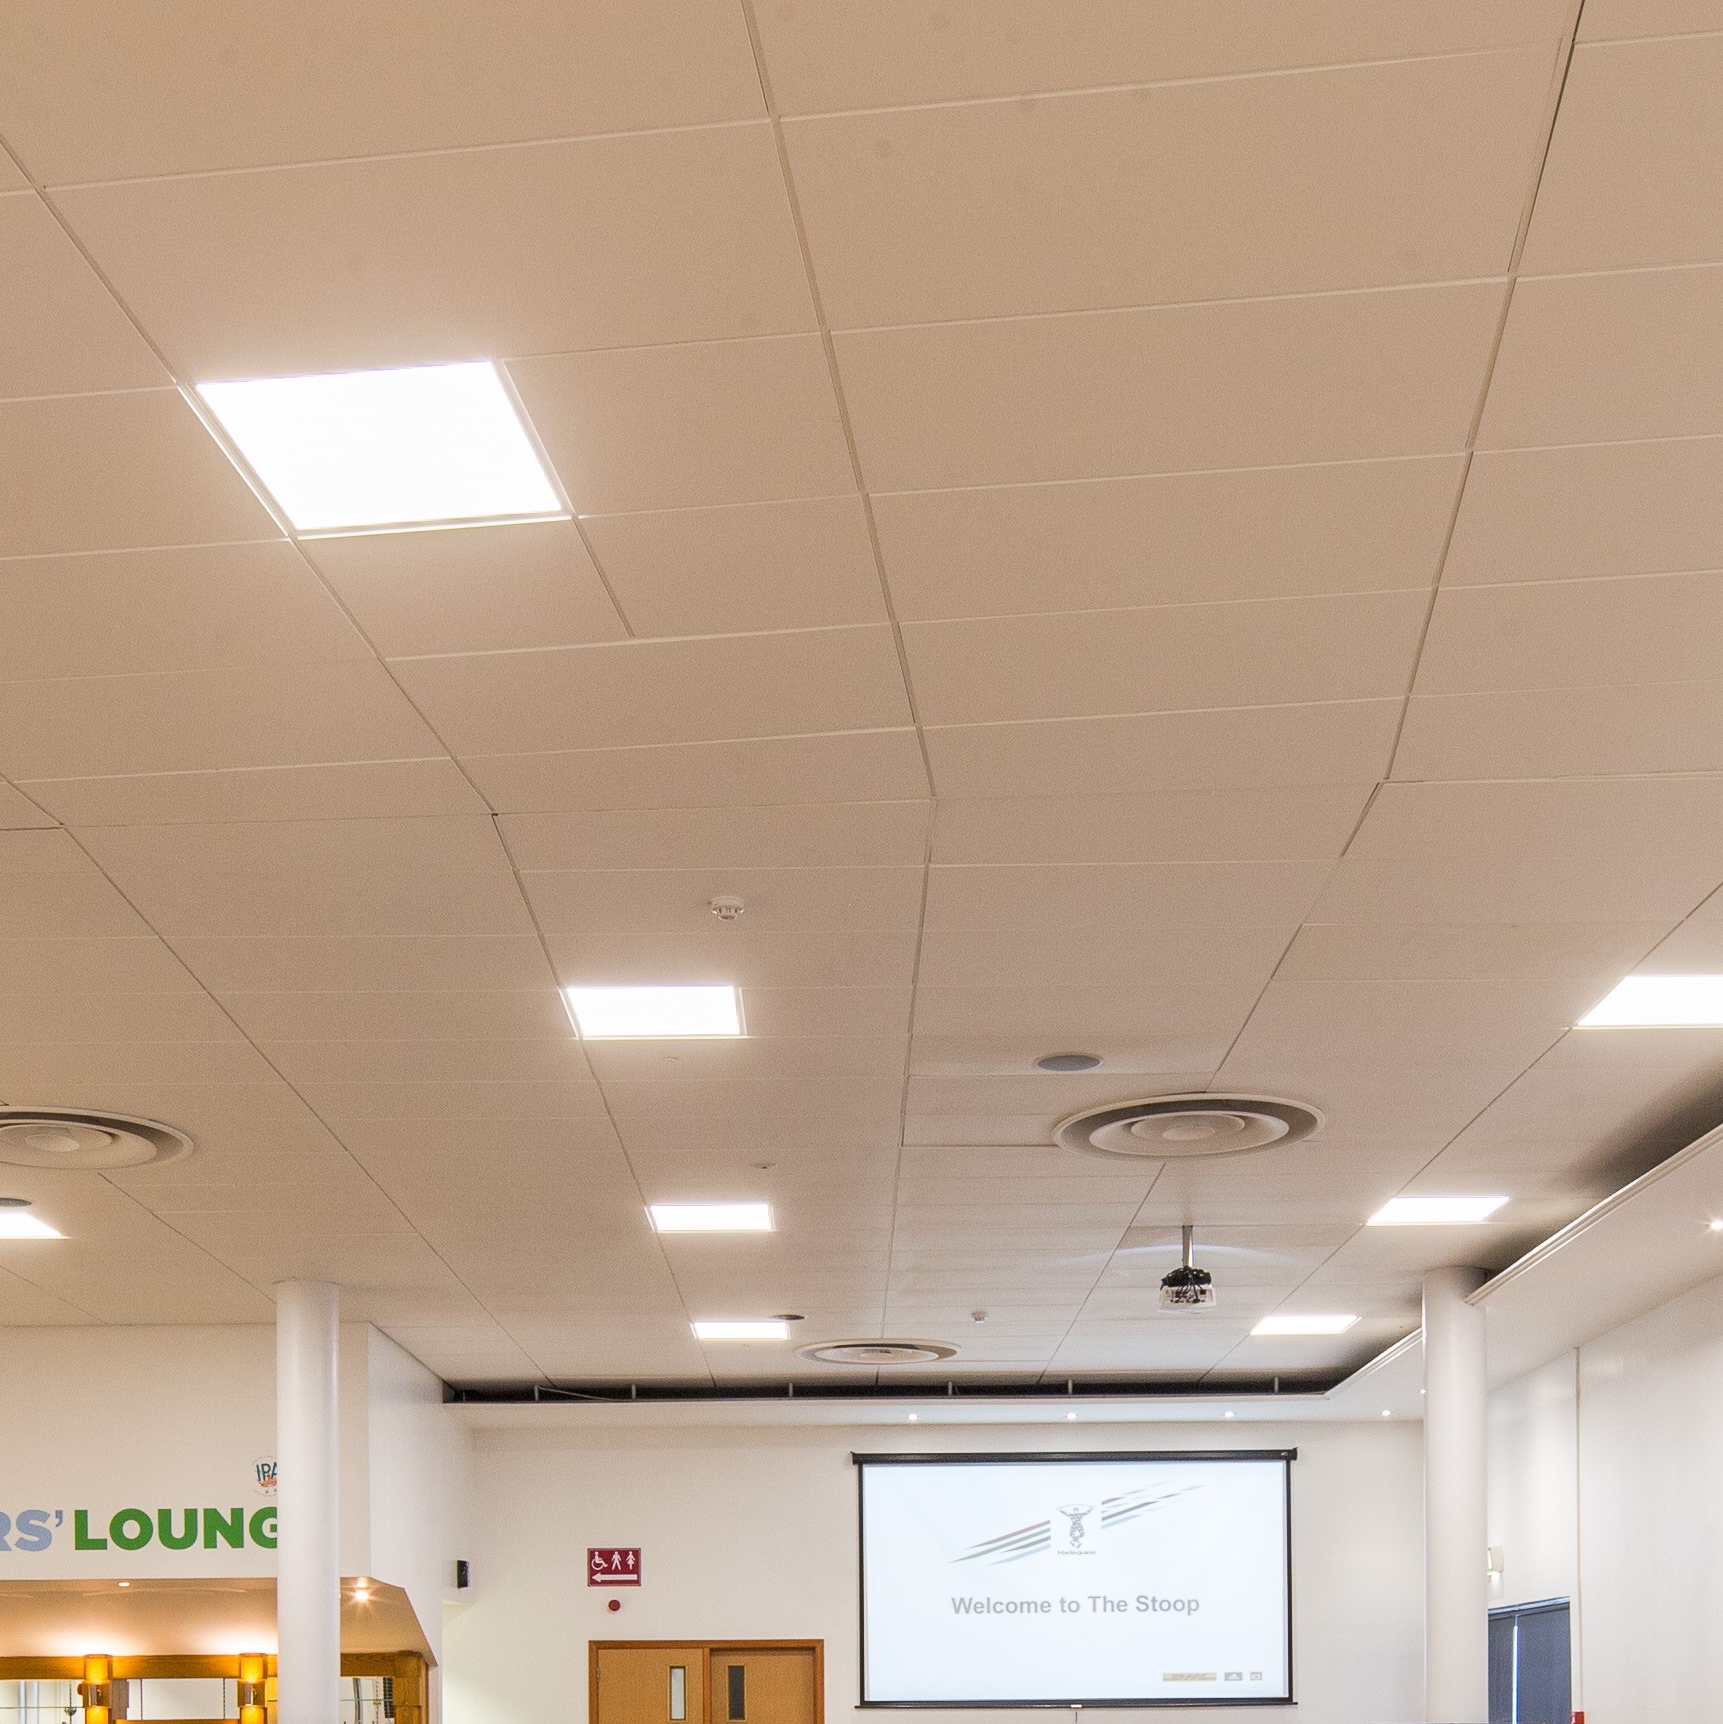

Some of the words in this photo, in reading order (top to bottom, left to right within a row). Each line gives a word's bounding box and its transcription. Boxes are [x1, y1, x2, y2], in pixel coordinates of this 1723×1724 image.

[74, 1507, 277, 1551] LOUNG
[951, 1596, 1052, 1614] Welcome
[1059, 1597, 1080, 1613] to
[1088, 1595, 1129, 1613] The
[1135, 1594, 1201, 1616] Stoop
